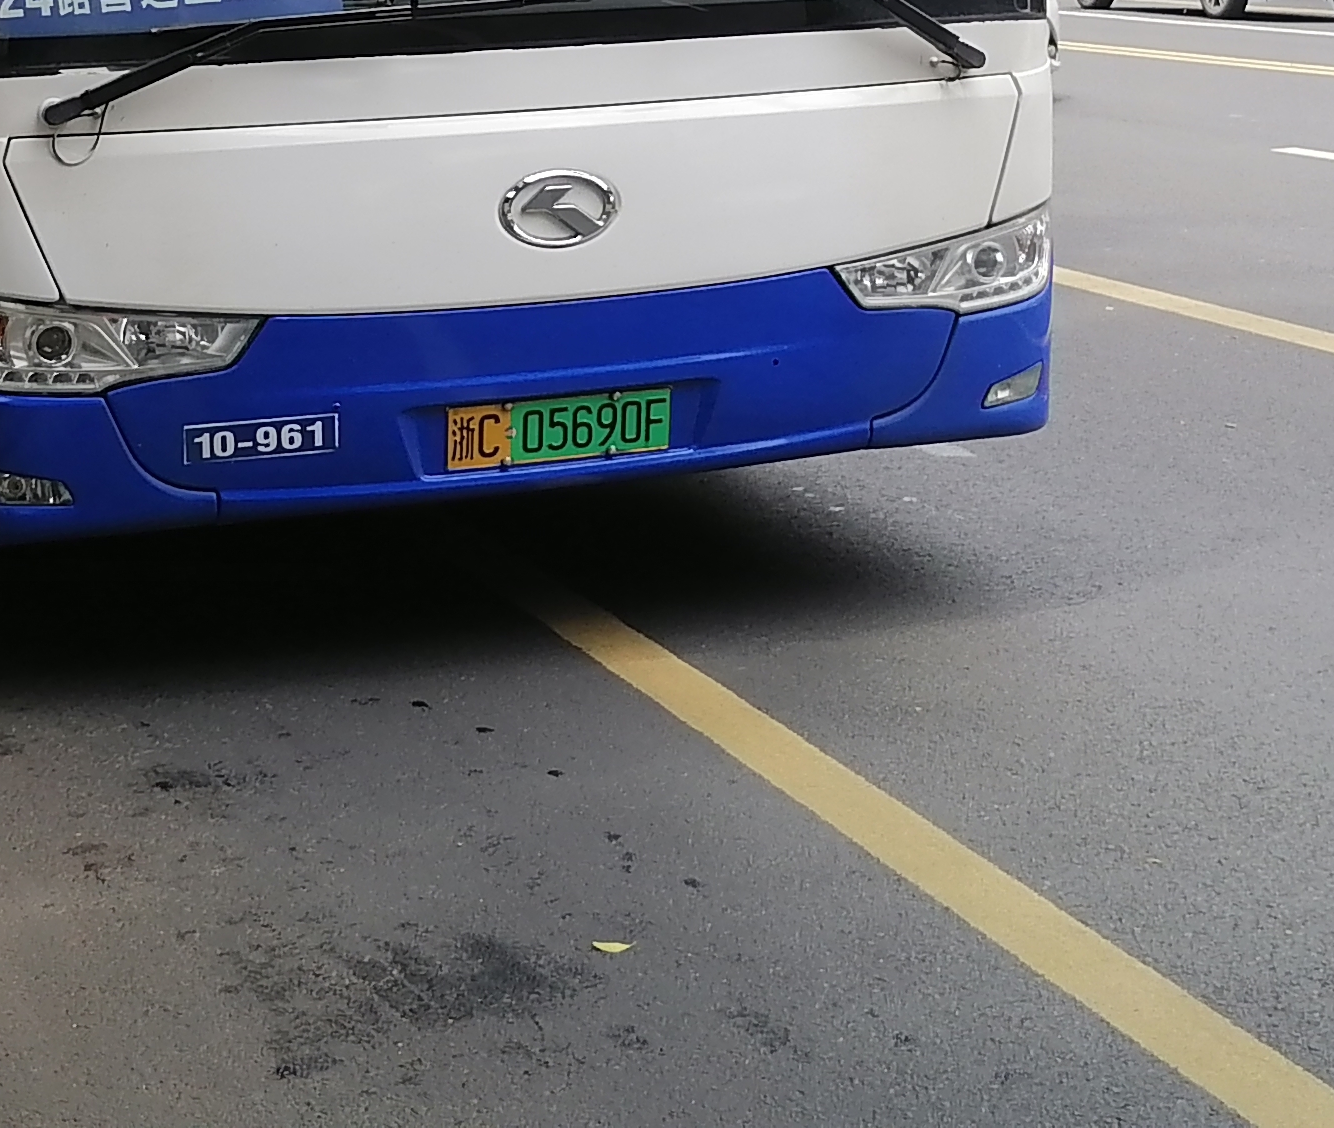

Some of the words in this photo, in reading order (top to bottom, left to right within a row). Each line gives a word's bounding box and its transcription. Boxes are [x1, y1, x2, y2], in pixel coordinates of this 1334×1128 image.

[193, 420, 325, 460] 10-961
[451, 413, 501, 462] 浙C
[522, 397, 667, 454] 05690F
